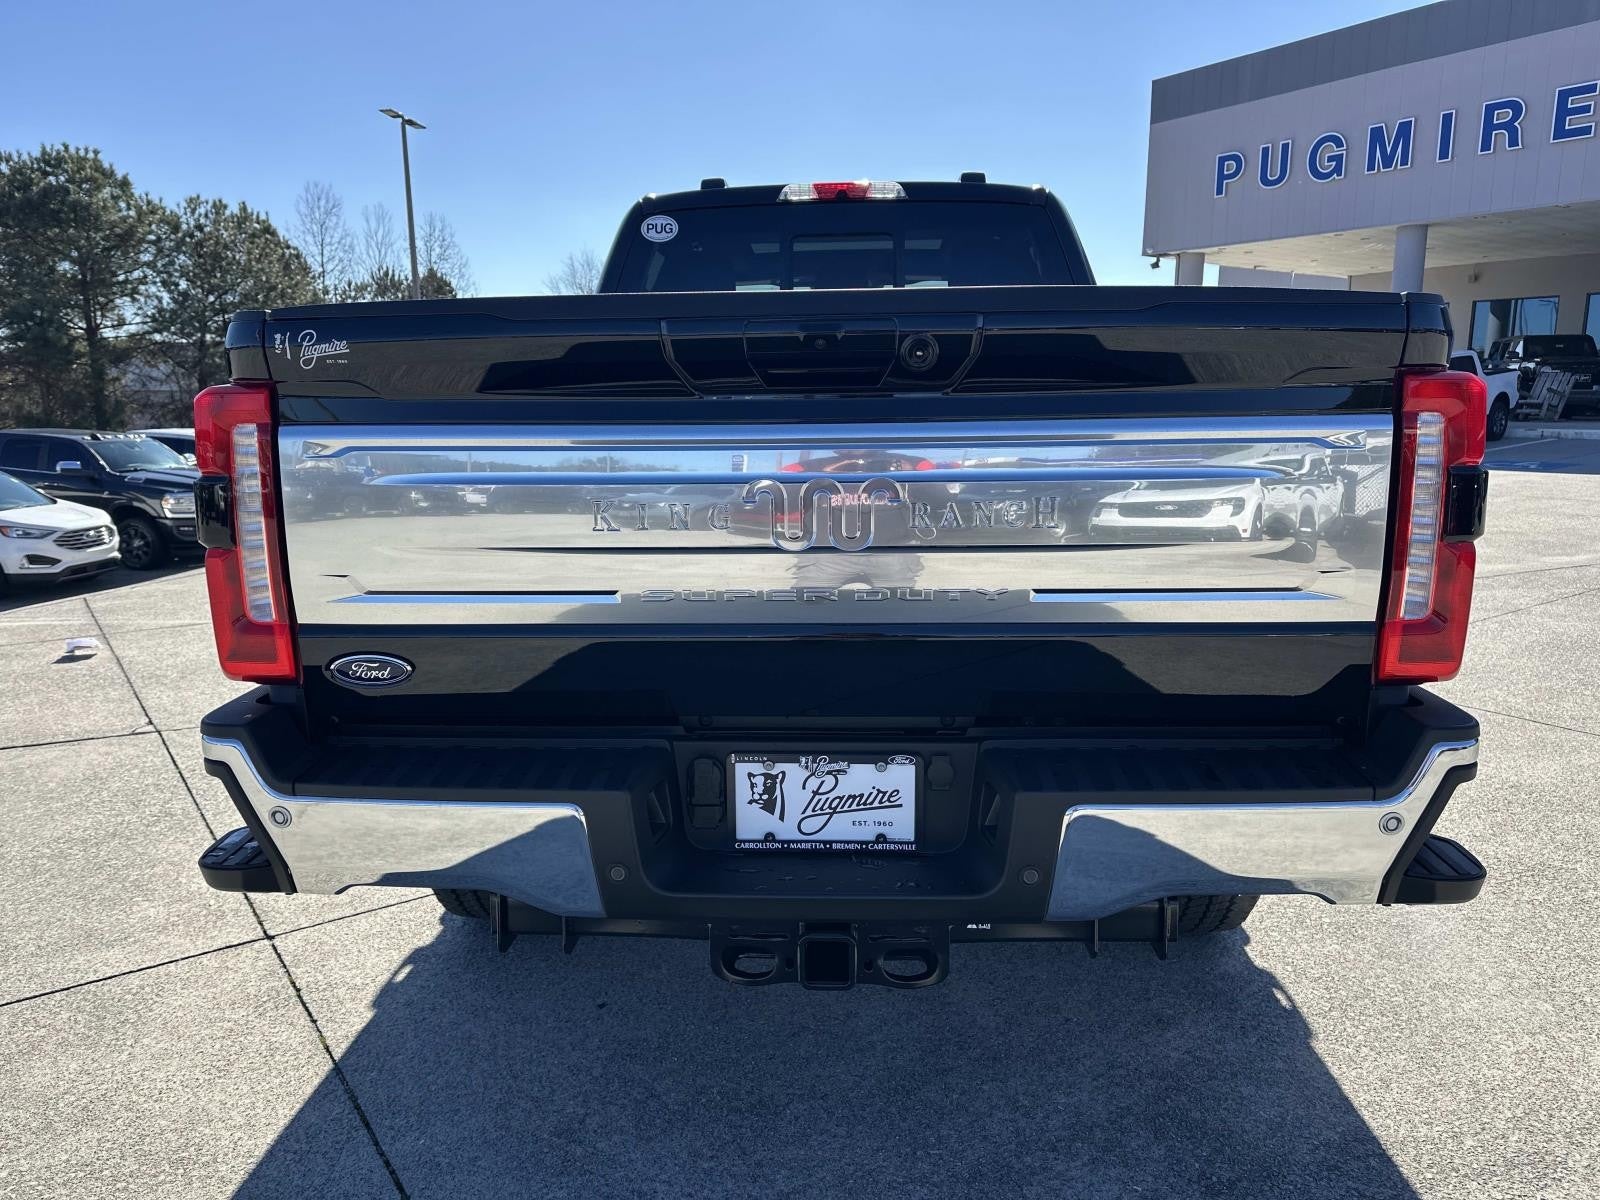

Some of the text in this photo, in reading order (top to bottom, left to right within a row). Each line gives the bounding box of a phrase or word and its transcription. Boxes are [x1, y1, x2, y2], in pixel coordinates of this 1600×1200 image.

[1213, 80, 1600, 199] PUGMIRE
[646, 222, 674, 234] PUG
[298, 329, 350, 370] Pugmire
[591, 495, 1061, 533] KING RANCH
[640, 588, 1010, 602] SUPER DUTY
[349, 661, 392, 679] Ford
[797, 771, 904, 836] Pugmire
